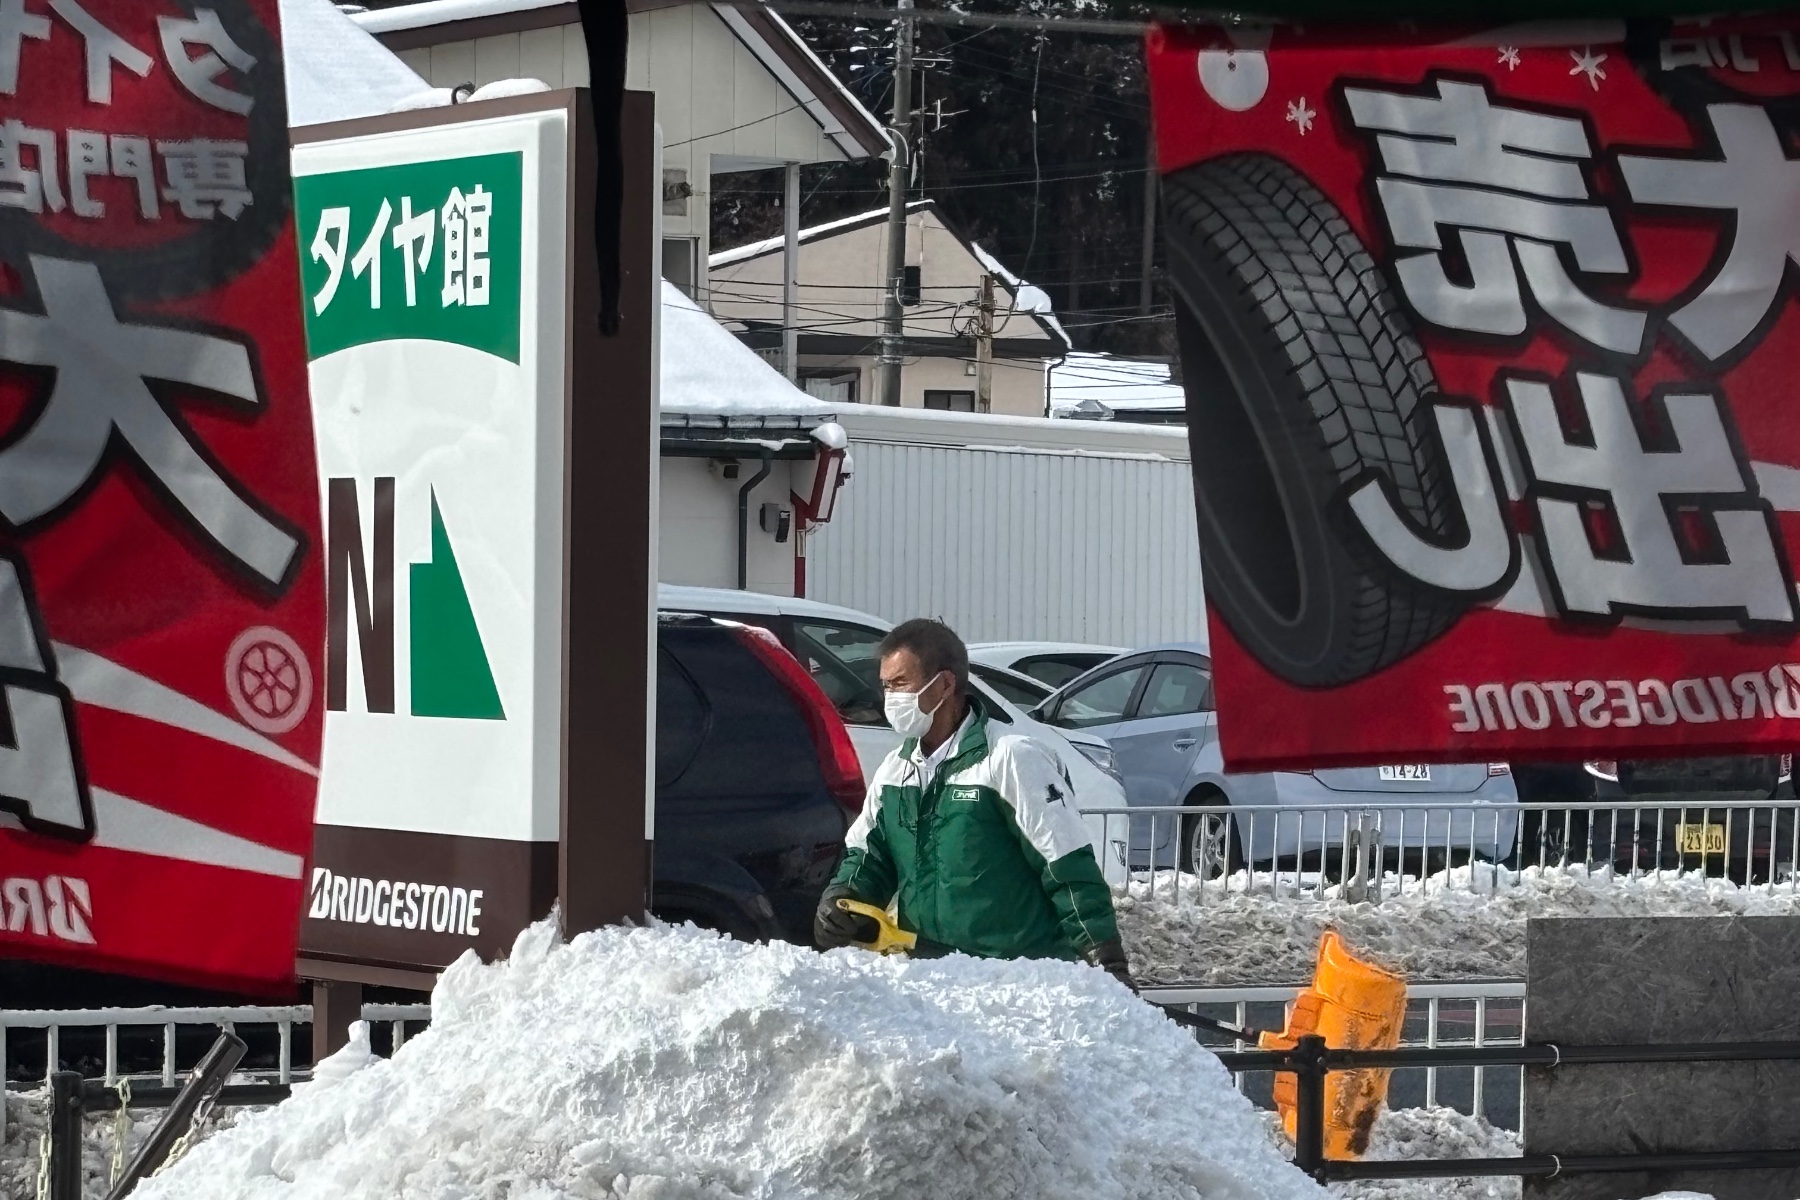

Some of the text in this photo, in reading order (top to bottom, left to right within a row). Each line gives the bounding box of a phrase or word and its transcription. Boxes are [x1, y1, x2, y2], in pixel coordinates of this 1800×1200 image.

[311, 184, 493, 317] タイヤ館
[309, 867, 484, 937] BRIDGESTONE
